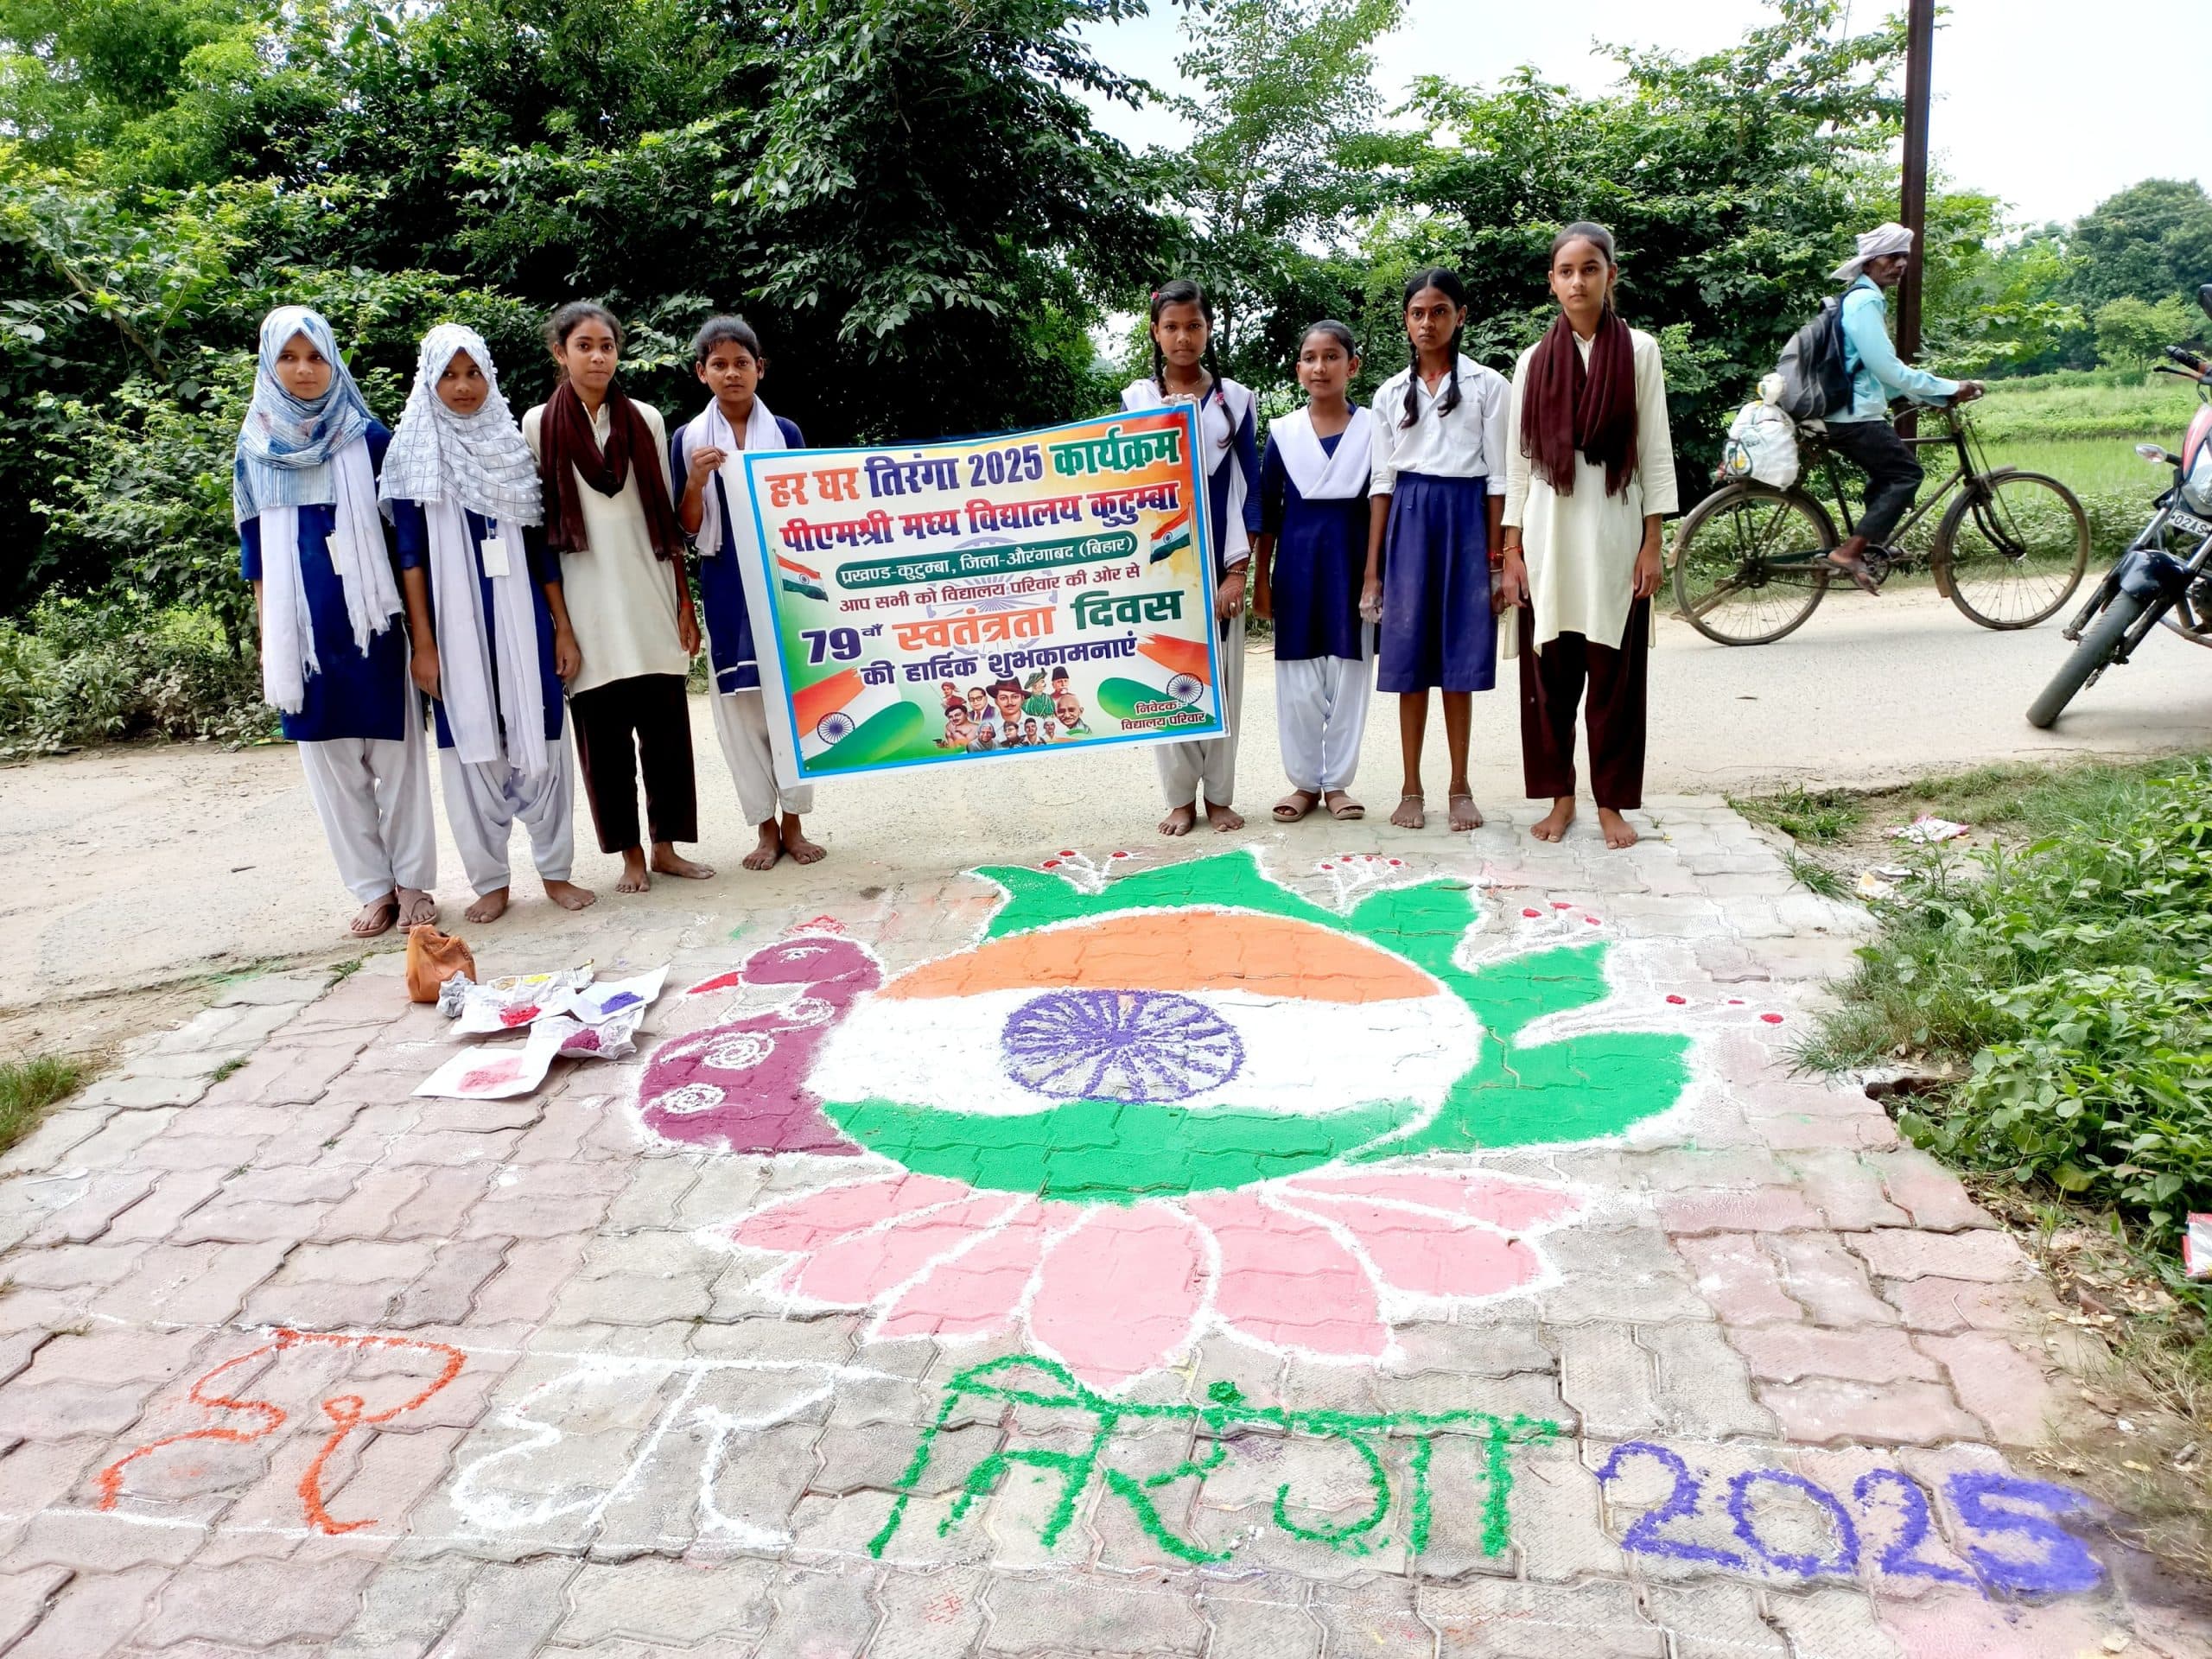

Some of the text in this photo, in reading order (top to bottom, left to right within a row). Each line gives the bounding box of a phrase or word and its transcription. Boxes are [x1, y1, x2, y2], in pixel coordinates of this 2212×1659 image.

[765, 427, 1179, 507] हर घर तिरंगा 2025 कार्यक्रम
[779, 482, 1179, 552] पीएमश्री मध्य विद्यालय कुटुम्बा
[1079, 536, 1133, 557] (बिहार)
[840, 562, 1141, 613] आप सभी को विद्यालय परिवार की ओर से
[892, 605, 1056, 651] स्वतंत्रता
[1070, 590, 1185, 630] दिवस
[861, 660, 894, 686] की
[902, 652, 978, 683] हार्दिक
[1121, 712, 1205, 730] विद्यालय परिवार
[97, 1325, 468, 1536] हर
[866, 1353, 1559, 1566] तिरंगा
[1599, 1440, 2106, 1601] 2025
